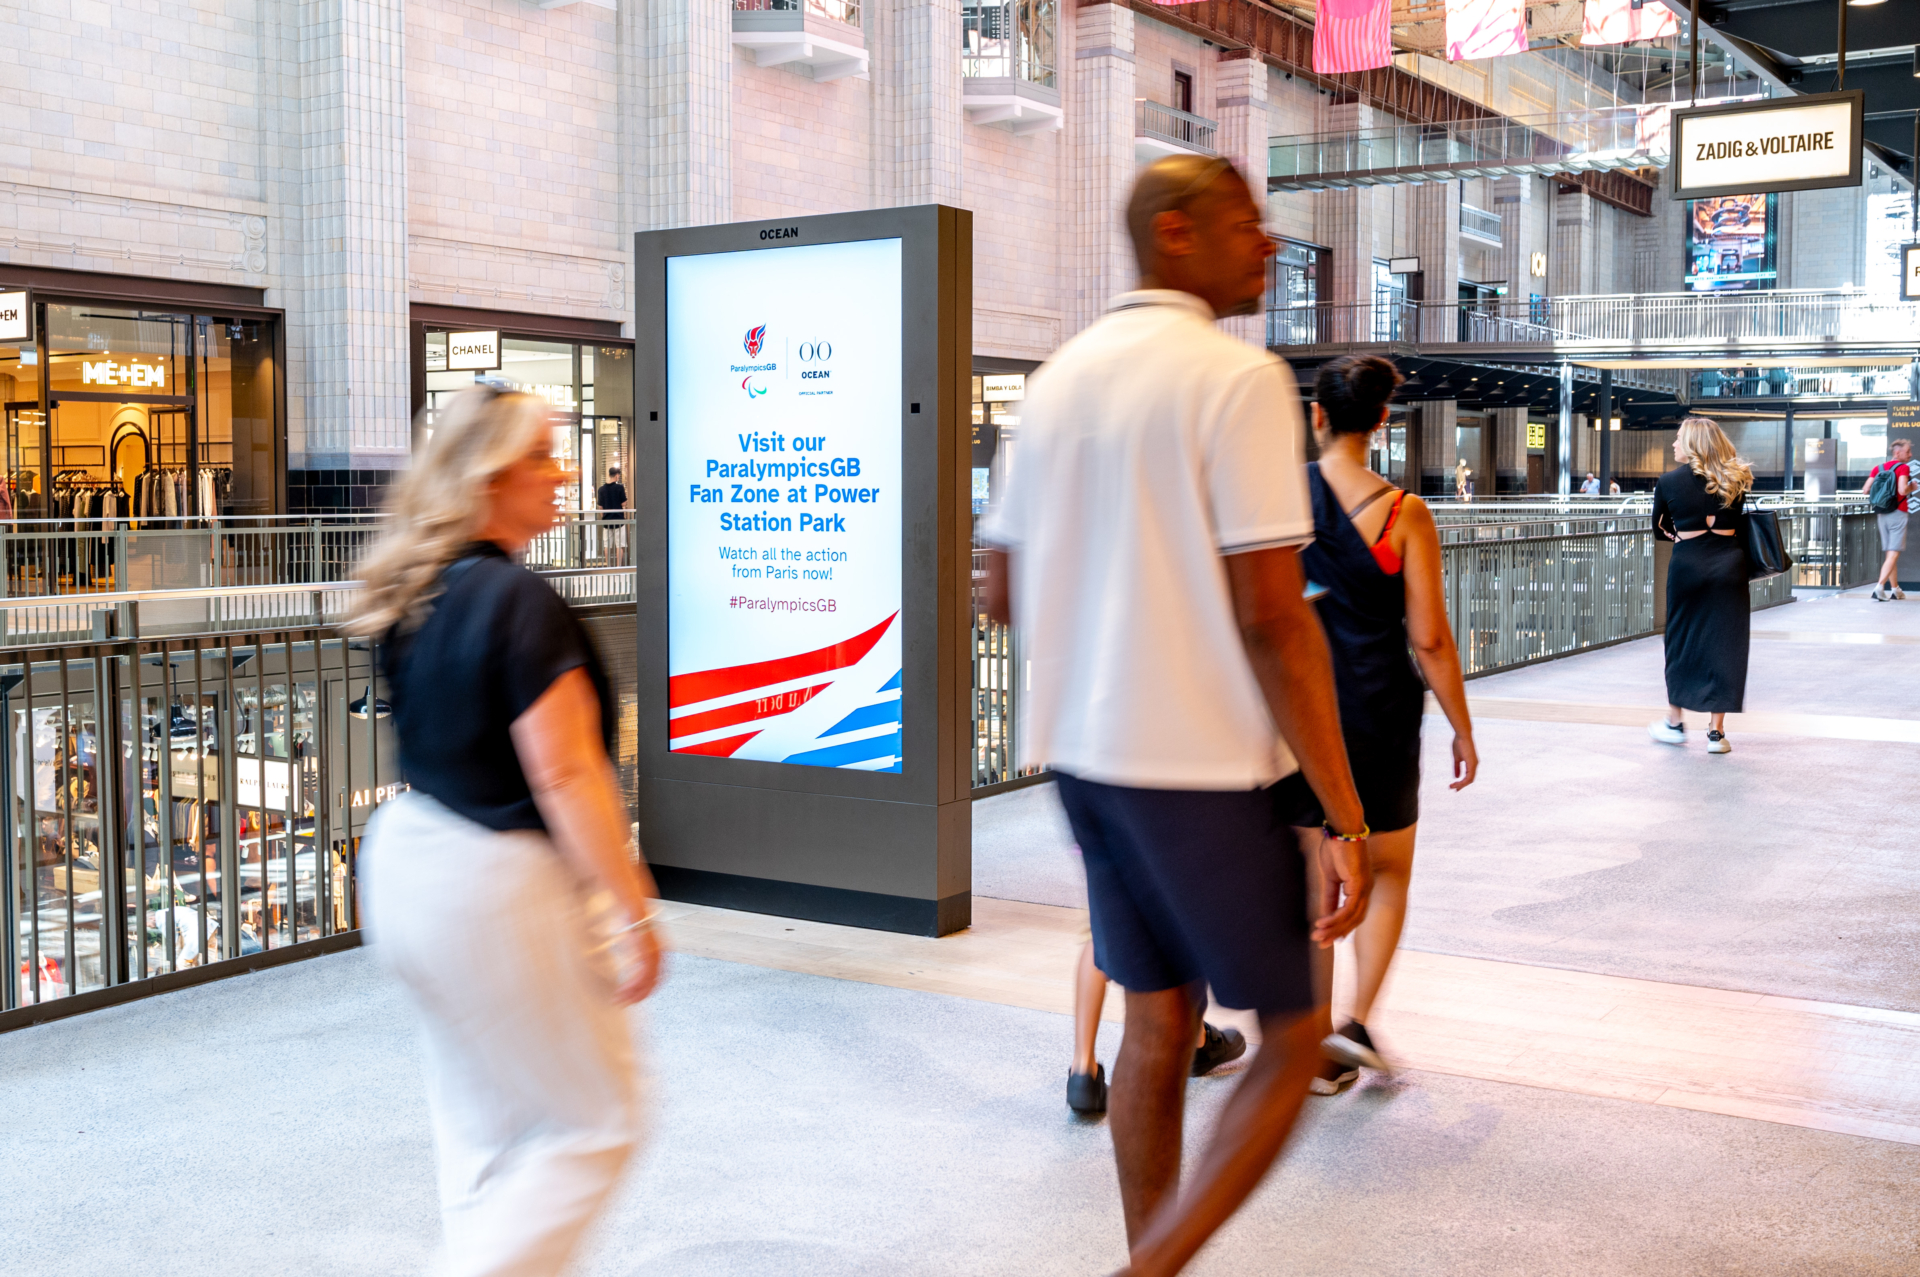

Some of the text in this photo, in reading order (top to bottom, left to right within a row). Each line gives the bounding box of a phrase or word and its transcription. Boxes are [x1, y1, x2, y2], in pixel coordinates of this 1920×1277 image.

[760, 226, 799, 240] OCEAN
[0, 309, 18, 321] +EM
[452, 344, 495, 356] CHANEL
[82, 361, 165, 388] ME+EM
[730, 363, 777, 373] ParalympicsGB
[801, 370, 830, 379] OCEAN
[738, 431, 826, 452] Visit our
[706, 456, 861, 481] ParalympicsGB
[690, 484, 880, 503] Fan Zone at Power
[720, 510, 846, 532] Station Park
[718, 546, 848, 562] Watch all the action
[732, 564, 833, 580] from Paris now!
[729, 596, 837, 613] #ParalympicsGB
[339, 785, 396, 808] ALPH
